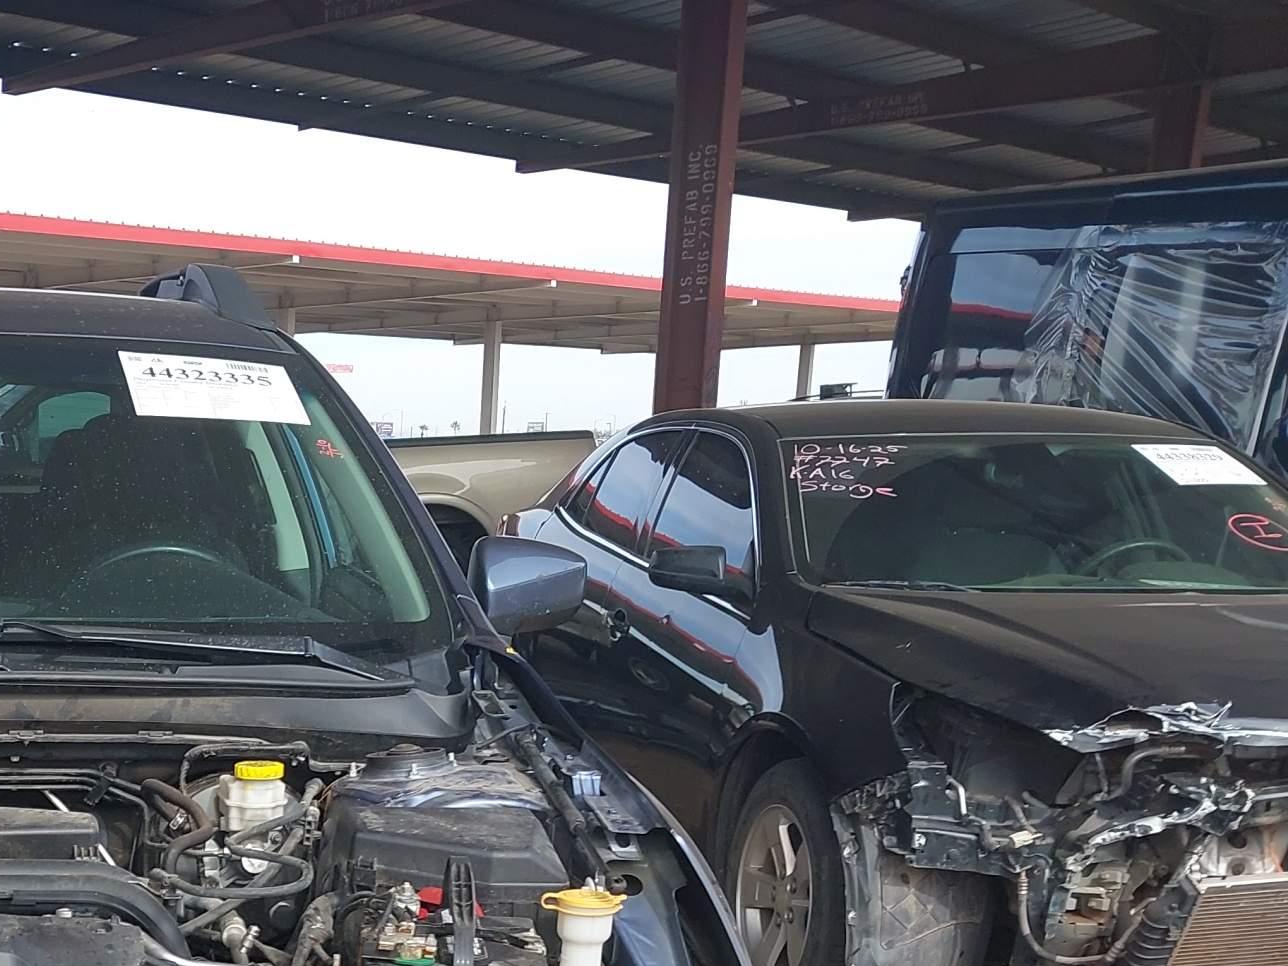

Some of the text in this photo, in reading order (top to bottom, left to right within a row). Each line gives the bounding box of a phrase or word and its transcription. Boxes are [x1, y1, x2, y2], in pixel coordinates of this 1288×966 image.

[679, 144, 703, 304] U.S. PREFAB INC.
[142, 366, 273, 387] 44323335
[794, 443, 908, 455] 10-16-25
